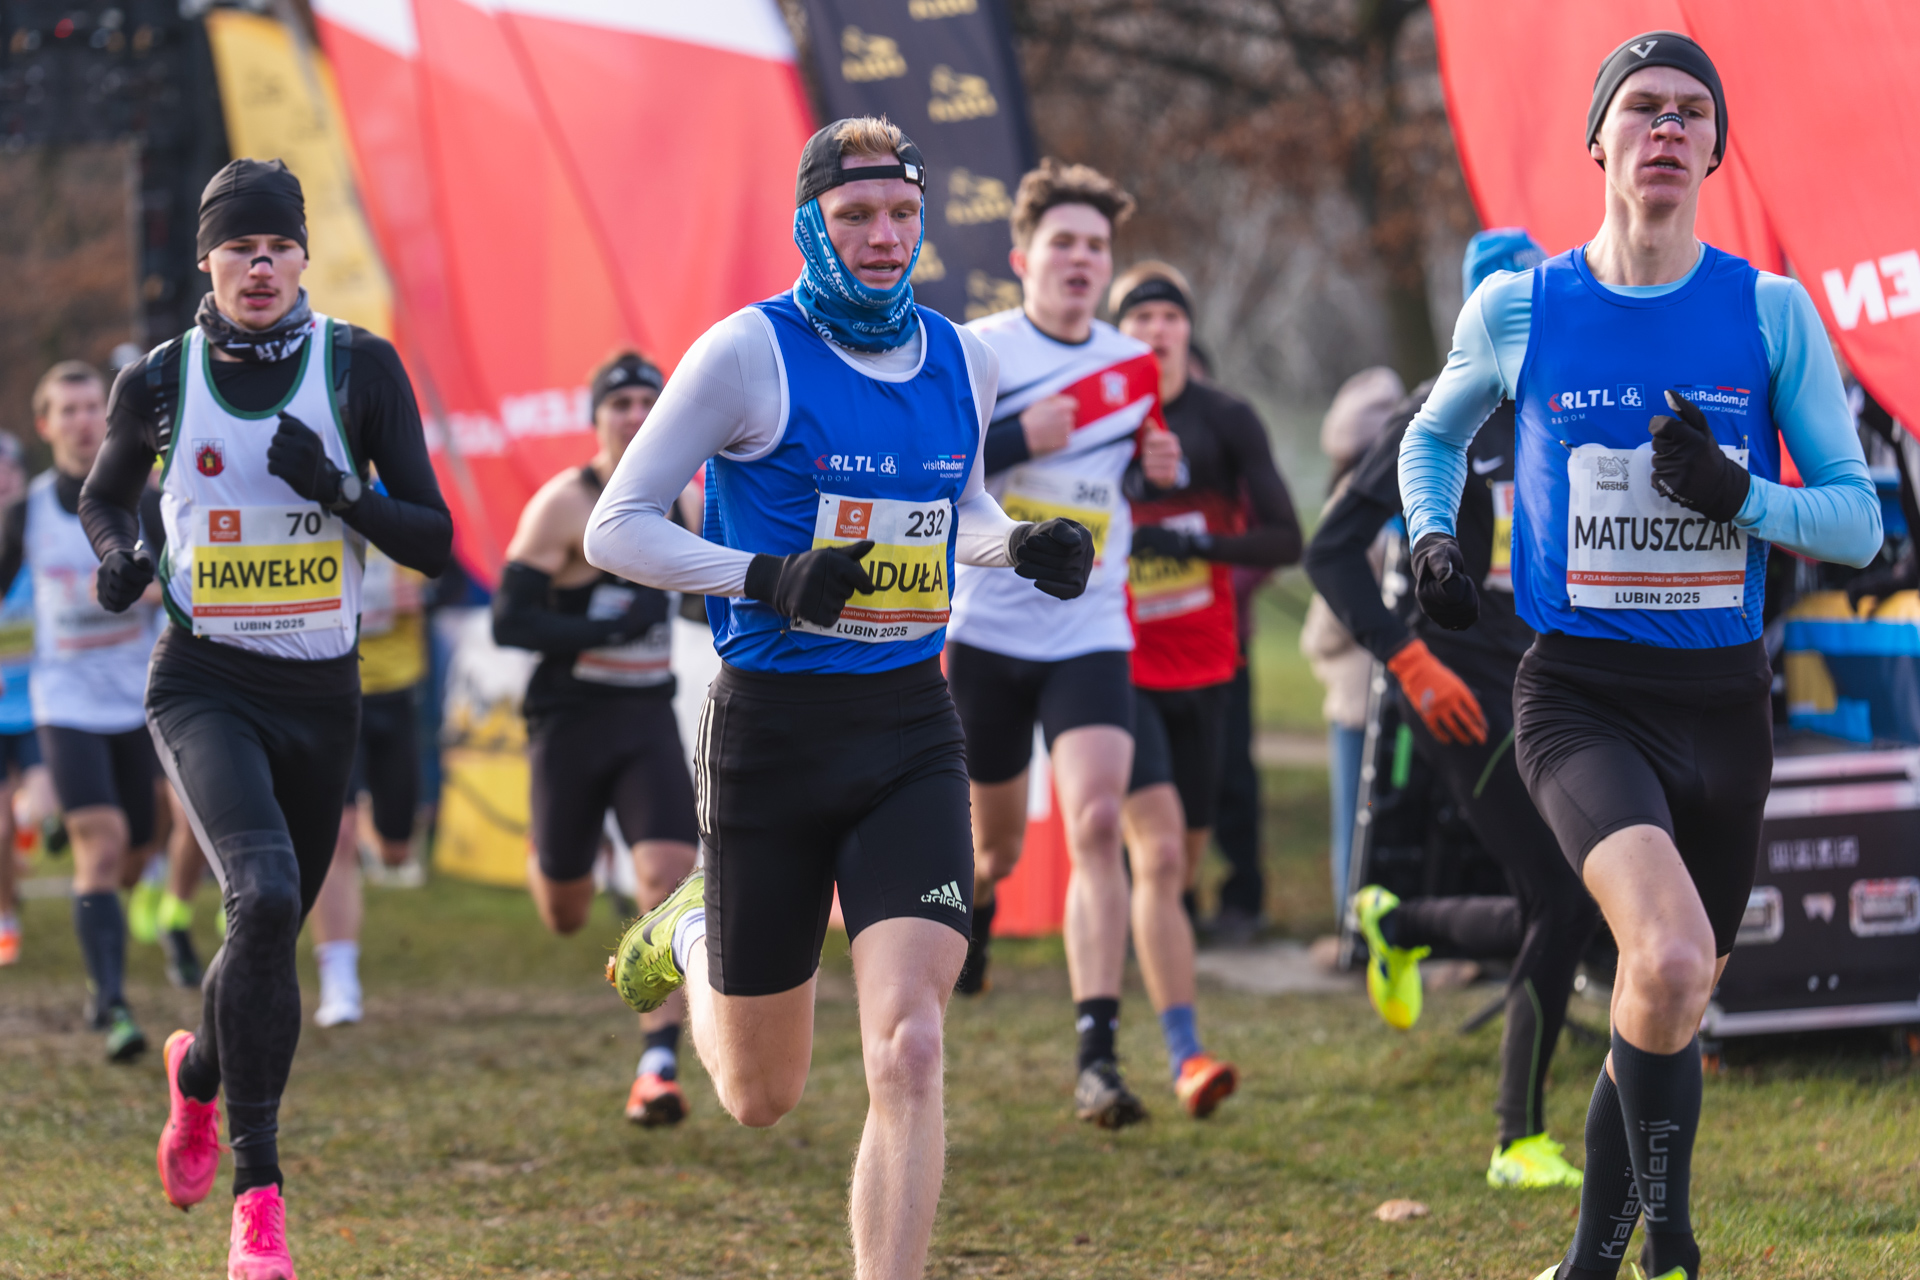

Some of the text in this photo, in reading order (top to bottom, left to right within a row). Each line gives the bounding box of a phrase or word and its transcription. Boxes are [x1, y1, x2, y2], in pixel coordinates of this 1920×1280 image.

[1561, 388, 1615, 410] RLTL
[1551, 413, 1586, 425] RADOM
[830, 454, 876, 473] RLTL
[813, 473, 850, 482] RADOM
[286, 511, 322, 537] 70
[905, 508, 946, 538] 232
[1575, 515, 1741, 552] MATUSZCZAK
[198, 556, 338, 589] HAWEŁKO
[1673, 575, 1700, 584] Biegach
[1615, 592, 1701, 604] LUBIN 2025
[841, 610, 866, 619] rzostwa
[866, 611, 884, 620] Polski
[890, 613, 911, 621] Biegach
[234, 617, 305, 632] LUBIN 2025
[836, 623, 908, 638] LUBIN 2025
